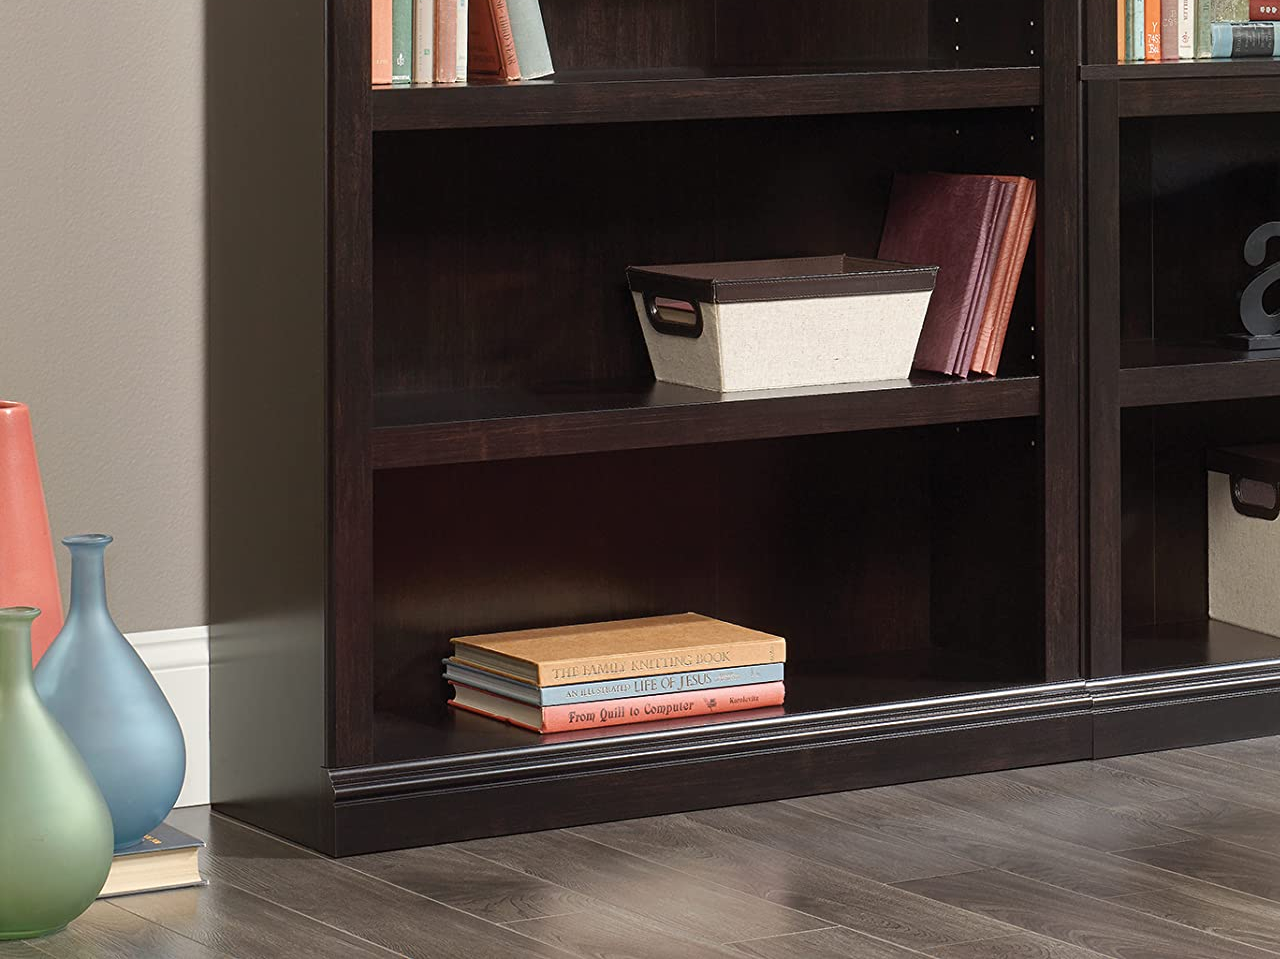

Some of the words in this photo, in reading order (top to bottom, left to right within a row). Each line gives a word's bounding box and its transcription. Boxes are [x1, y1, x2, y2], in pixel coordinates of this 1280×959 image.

[1152, 21, 1159, 32] Y
[503, 43, 516, 66] YEAR
[552, 667, 579, 679] THE
[583, 661, 626, 676] FAMILY
[631, 654, 693, 671] KNITTING
[695, 651, 731, 664] BOOK
[566, 690, 578, 698] AN
[580, 684, 630, 697] ILLUSTRATED
[634, 679, 657, 693] LIFE
[661, 677, 676, 689] OF
[677, 673, 712, 690] JESUS
[568, 711, 596, 723] From
[599, 707, 625, 723] Quill
[629, 706, 640, 716] to
[644, 701, 695, 715] Computer
